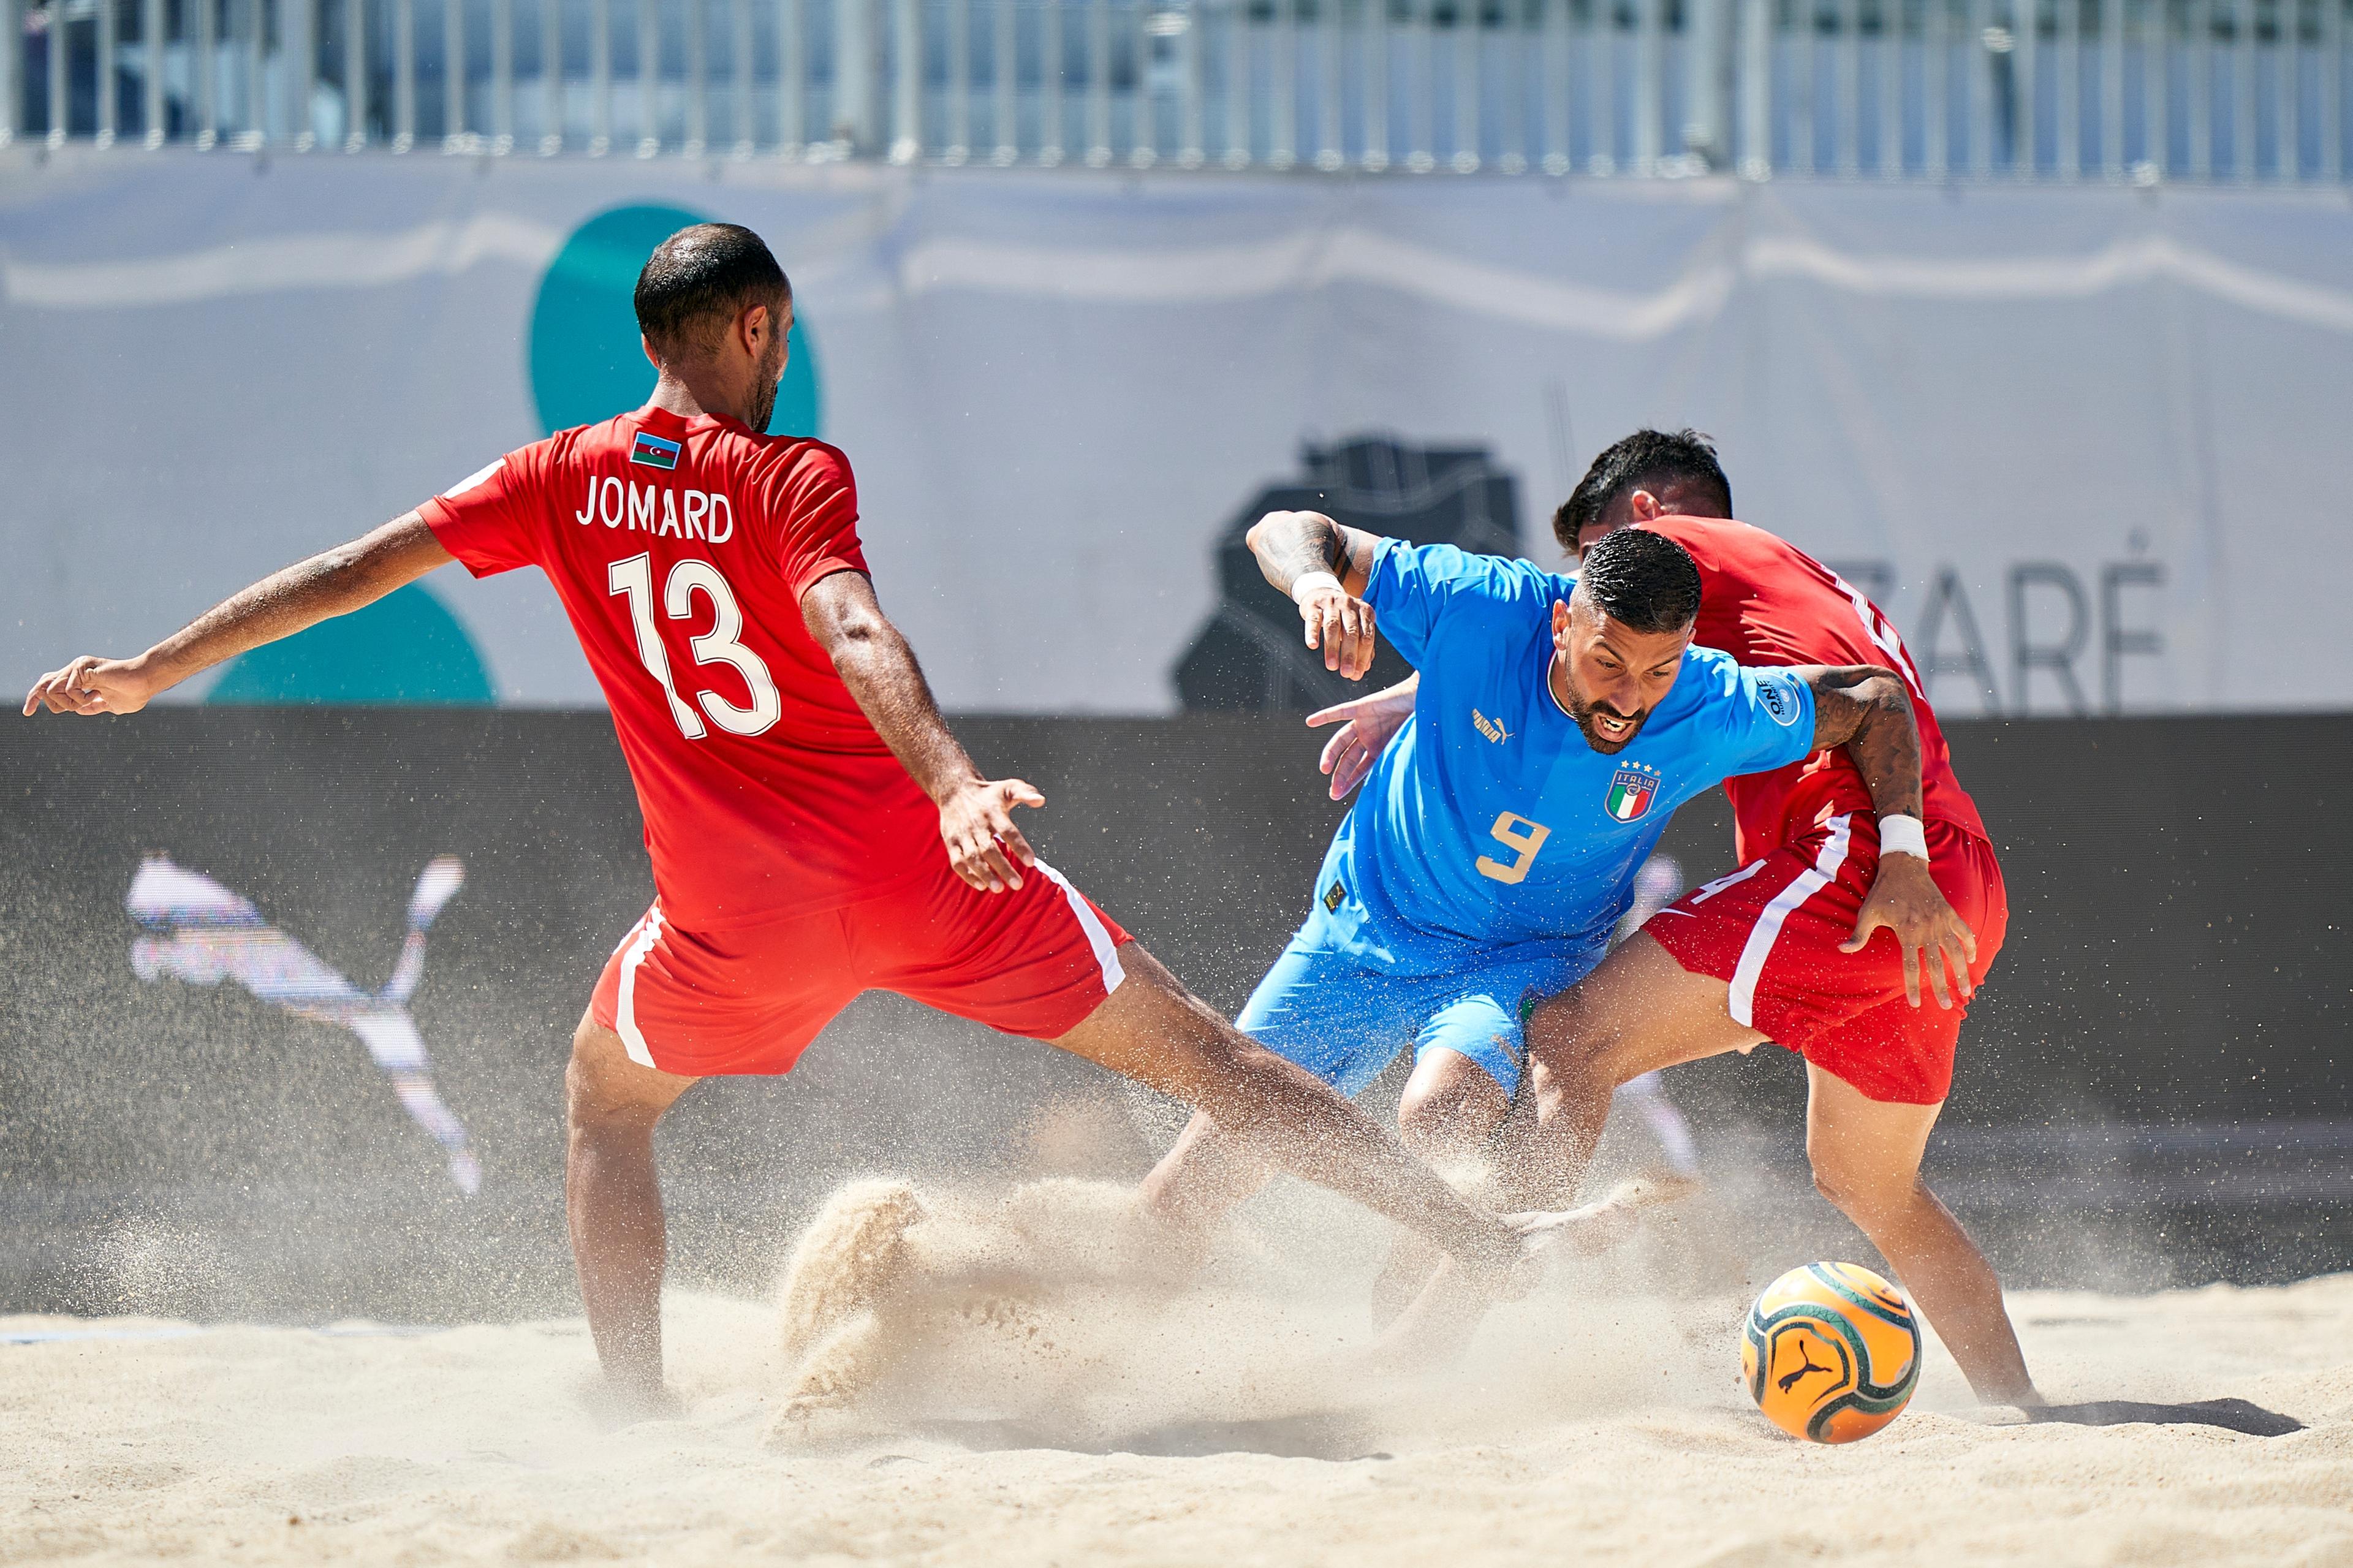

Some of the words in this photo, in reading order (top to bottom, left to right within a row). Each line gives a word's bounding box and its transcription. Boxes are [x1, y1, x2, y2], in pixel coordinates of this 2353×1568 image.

[576, 475, 733, 543] JOMARD
[608, 550, 781, 739] 13
[1756, 677, 1780, 715] ONE
[1472, 708, 1501, 744] PUMA
[1618, 774, 1654, 787] ITALIA
[1475, 811, 1552, 884] 9
